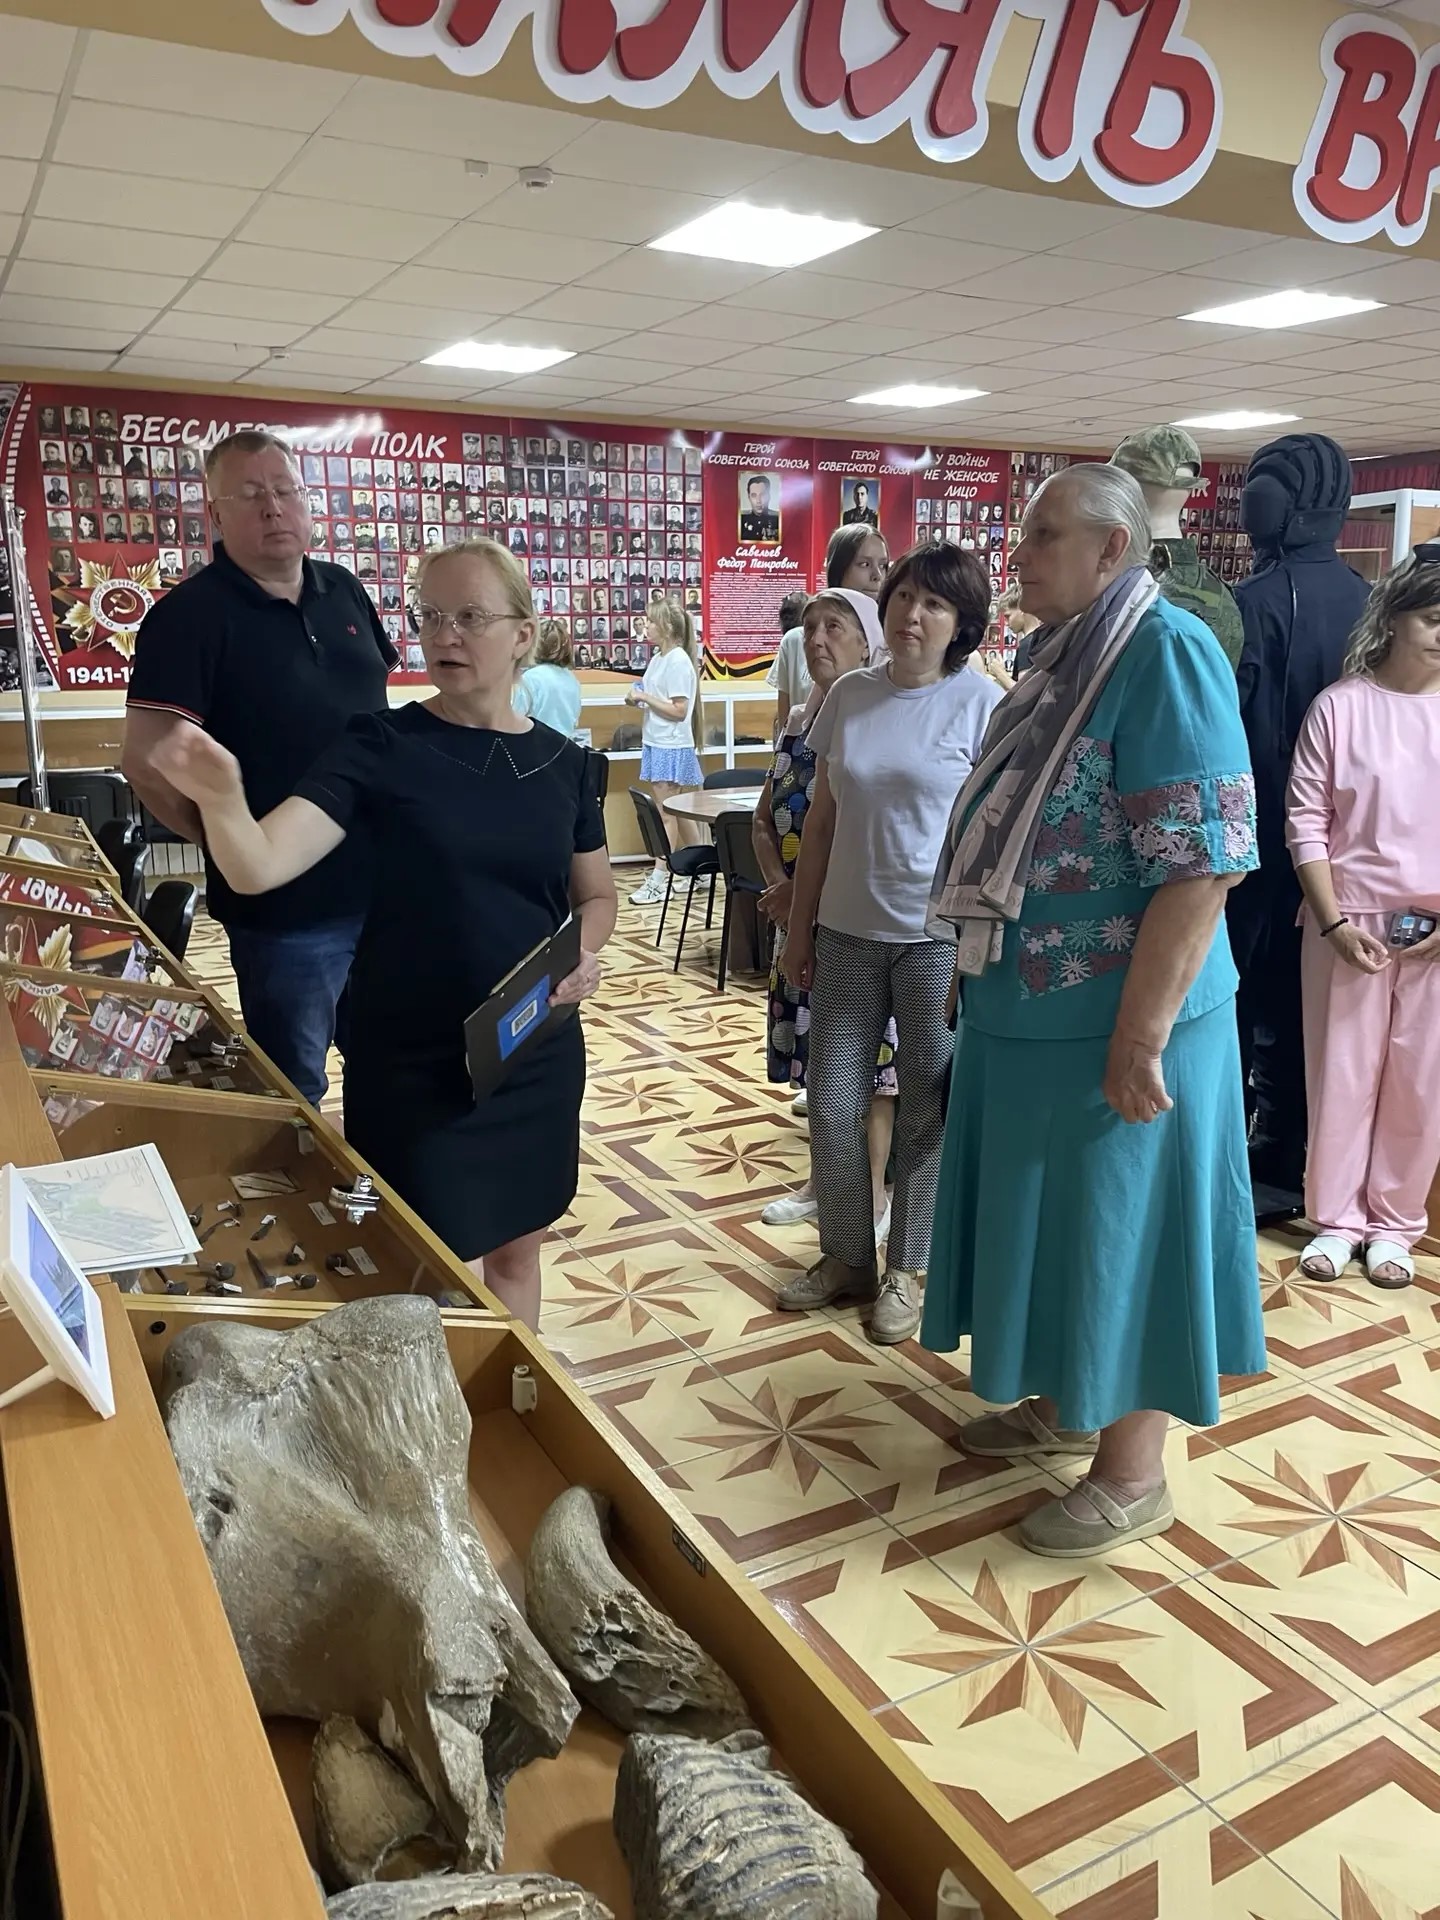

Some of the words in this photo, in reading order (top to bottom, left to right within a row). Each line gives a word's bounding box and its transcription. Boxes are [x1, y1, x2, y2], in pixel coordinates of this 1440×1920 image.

[119, 413, 354, 455] БЕССМЫЙ
[370, 431, 448, 459] ПОЛК
[743, 442, 776, 454] ГЕРОЙ
[850, 449, 880, 461] ГЕРОЙ
[708, 454, 772, 467] СОВЕТСКОГО
[774, 458, 810, 470] СОЮЗА
[935, 453, 944, 466] У
[946, 452, 990, 468] ВОЙНЫ
[817, 461, 877, 474] СОВЕТСКОГО
[878, 464, 912, 476] СОЮЗА
[923, 469, 942, 481] НЕ
[943, 469, 1000, 484] ЖЕНСКОЕ
[944, 485, 979, 500] ЛИЦО
[735, 544, 783, 558] Савельев
[717, 556, 748, 573] Федор
[749, 556, 799, 573] Петрович
[66, 666, 134, 684] 1941-1
